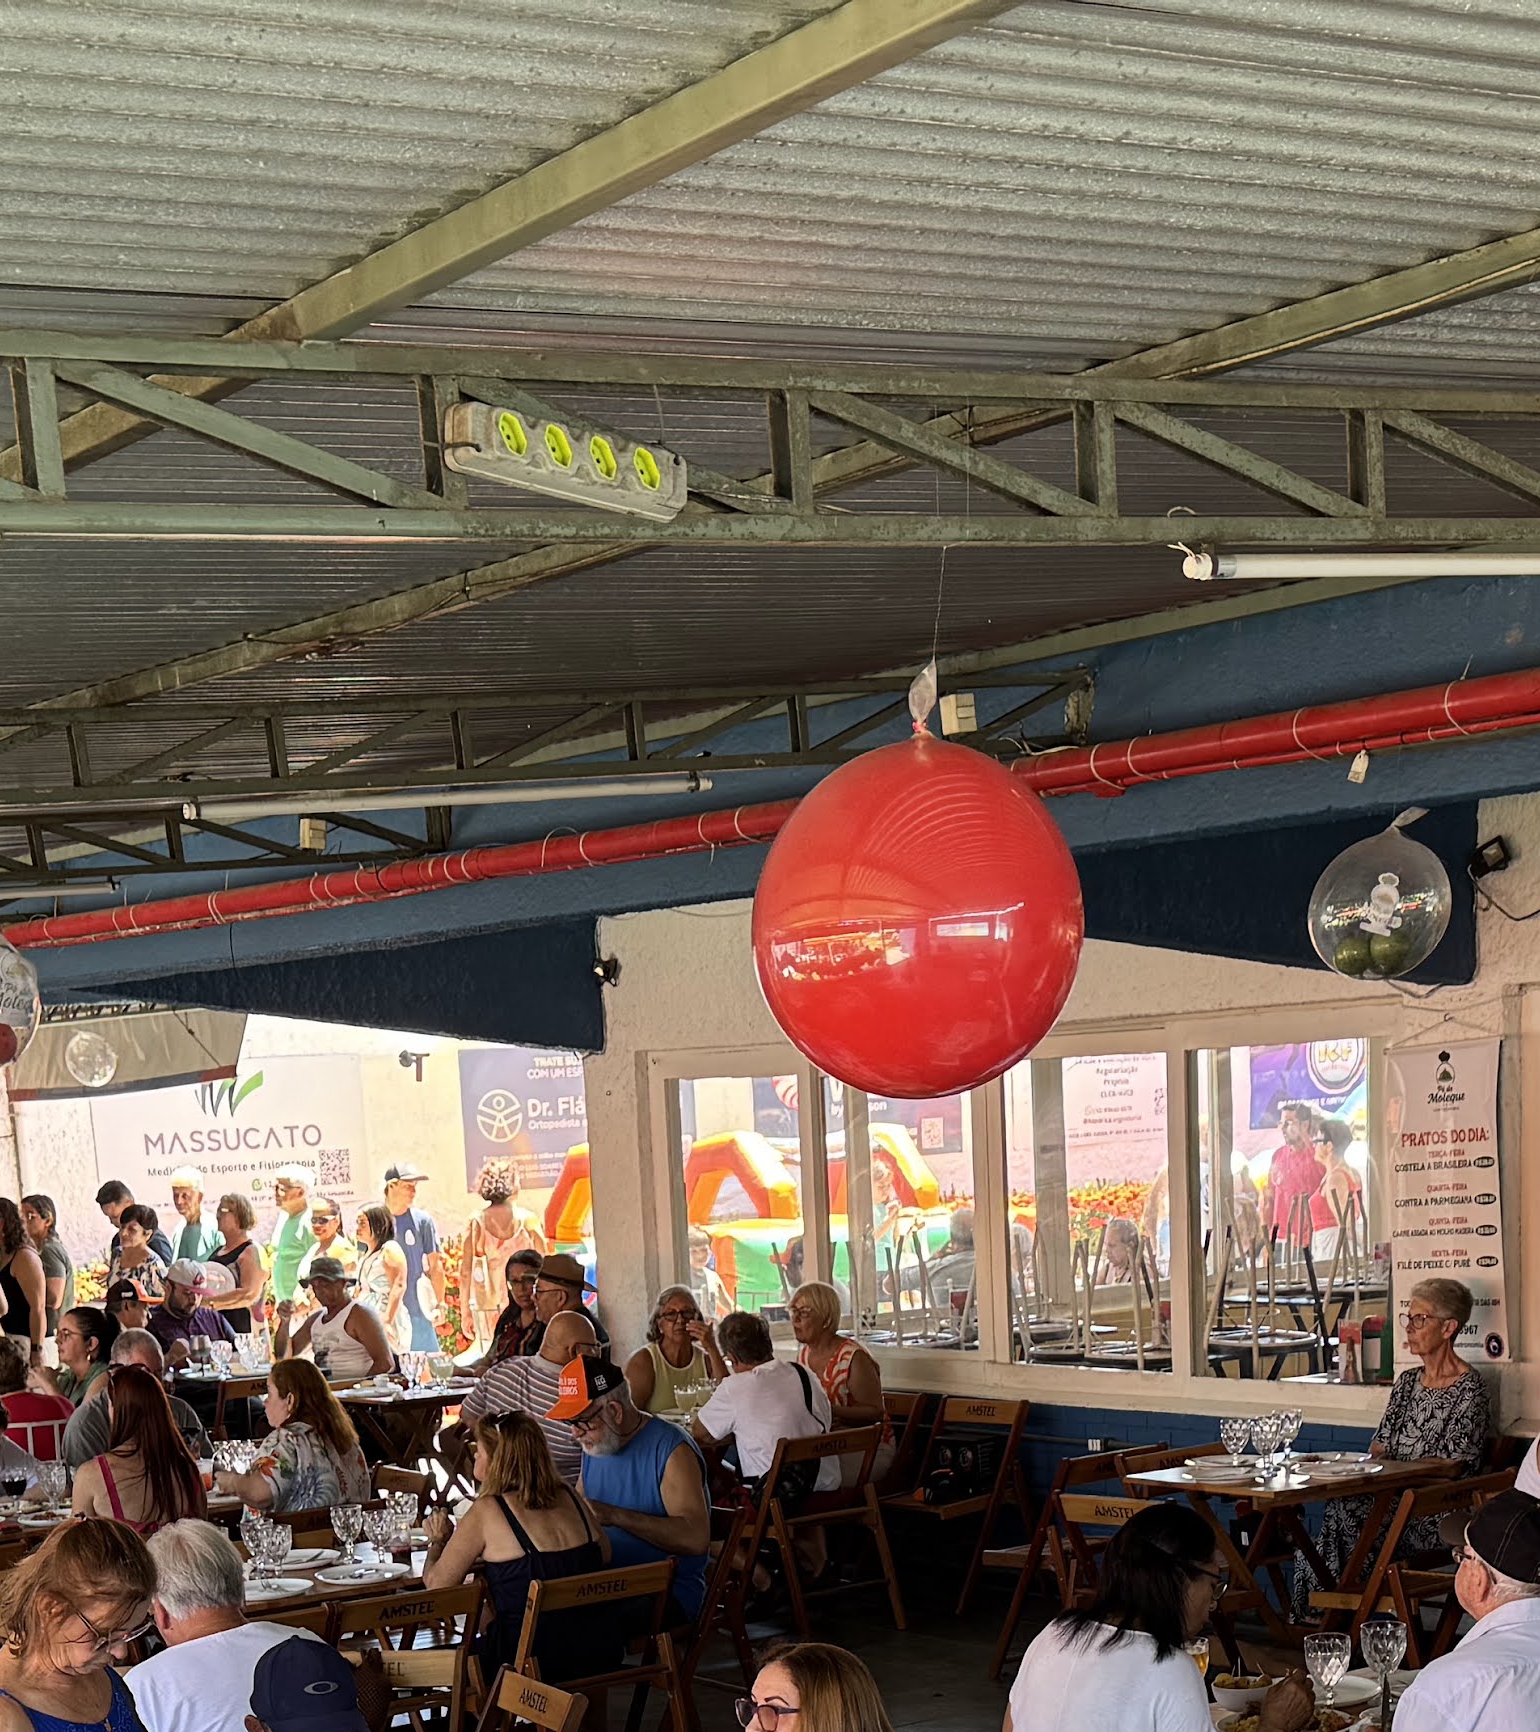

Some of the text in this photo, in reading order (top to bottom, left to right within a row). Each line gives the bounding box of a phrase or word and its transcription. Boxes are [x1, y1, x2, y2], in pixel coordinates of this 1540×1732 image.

[527, 1068, 548, 1079] COM
[550, 1067, 565, 1078] UM
[1427, 1092, 1465, 1104] Moleque
[527, 1098, 552, 1117] Dr.
[144, 1124, 322, 1156] MASSUCATO
[1402, 1127, 1490, 1147] PRATOS DO DIA:
[211, 1163, 248, 1175] Esporte
[1395, 1162, 1425, 1172] COSTELA
[1395, 1198, 1423, 1208] CONTRA
[1413, 1260, 1422, 1269] DE
[966, 1405, 996, 1417] AMSTEL
[576, 1579, 629, 1598] AMSTEL
[379, 1602, 436, 1622] AMSTEL
[519, 1687, 548, 1714] AMSTEL
